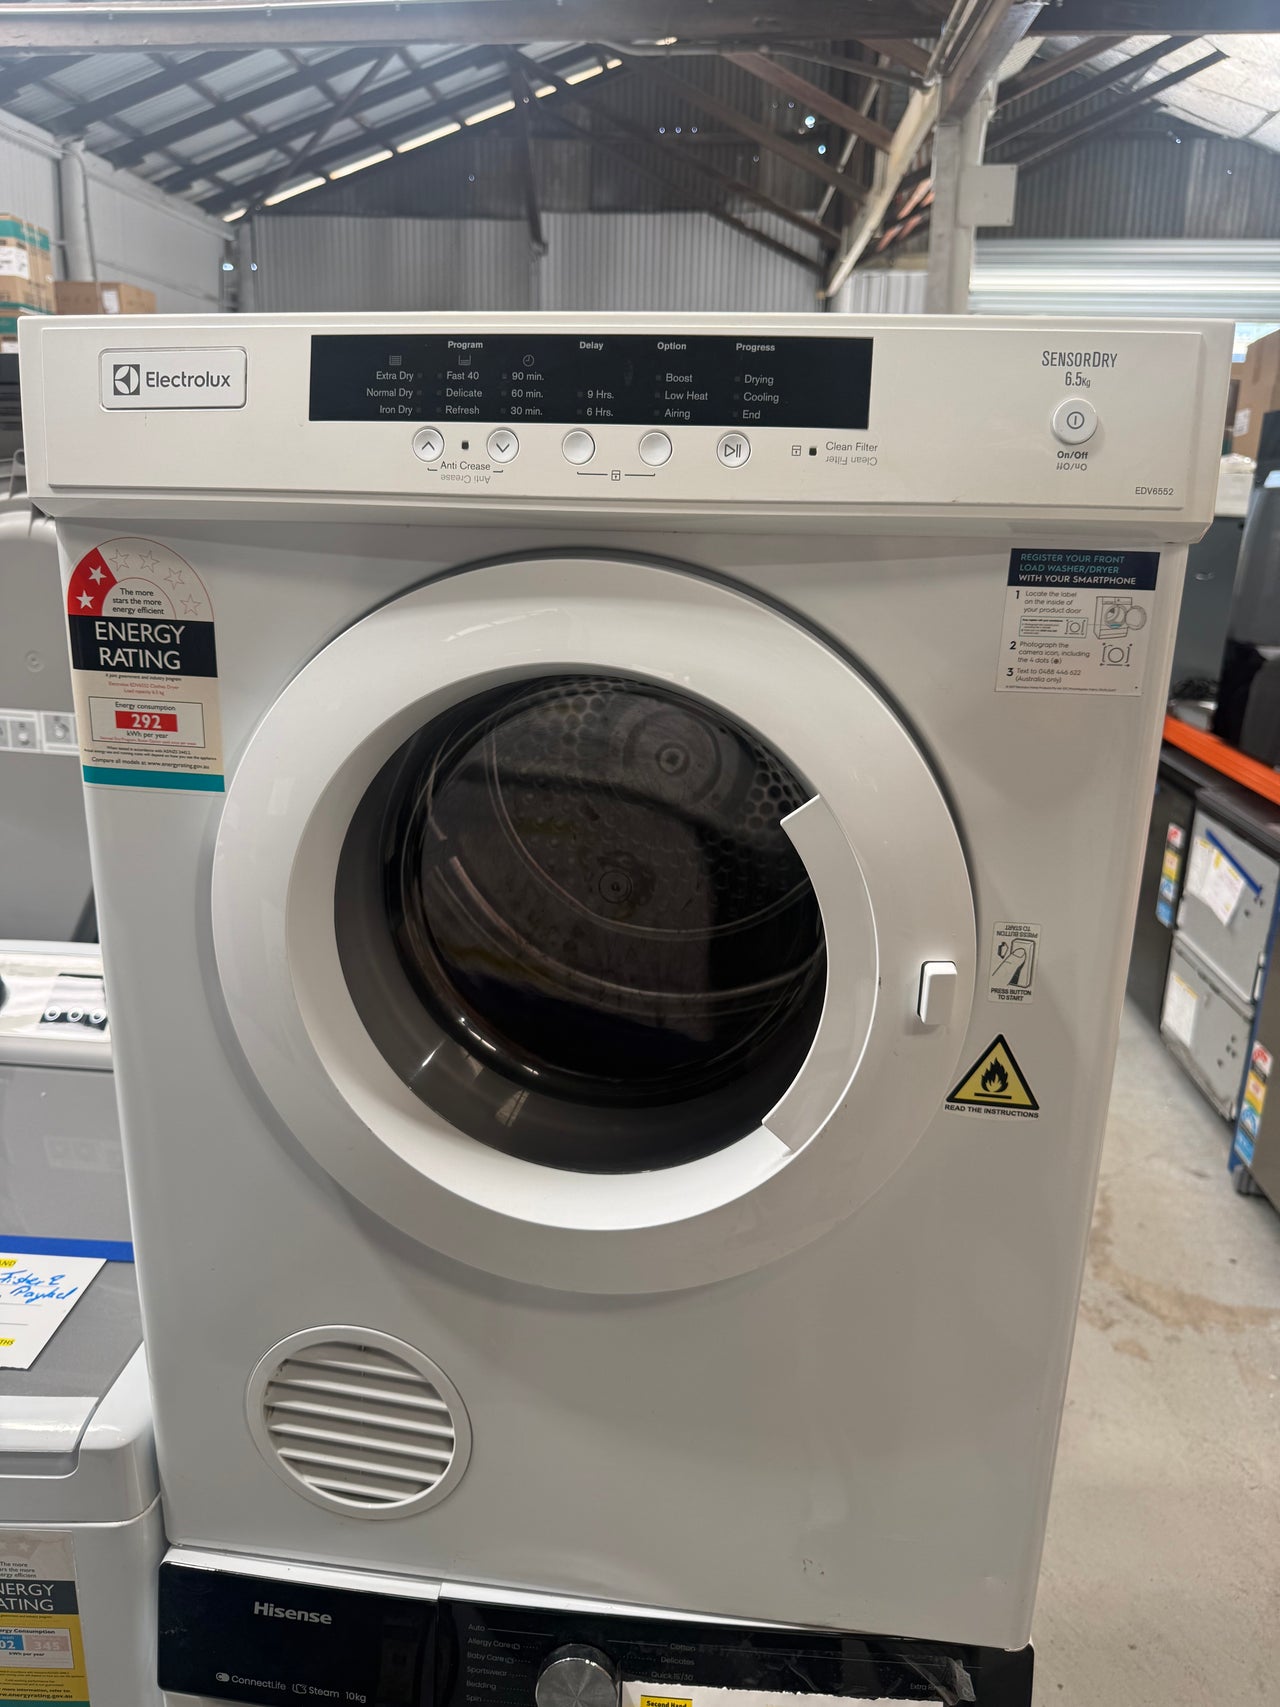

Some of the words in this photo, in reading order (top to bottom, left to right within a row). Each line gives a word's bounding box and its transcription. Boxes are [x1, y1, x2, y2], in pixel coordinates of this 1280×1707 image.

[447, 340, 483, 350] Program
[579, 341, 603, 351] Delay
[657, 341, 687, 351] Option
[735, 342, 775, 353] Progress
[146, 371, 231, 388] Electrolux
[376, 371, 397, 381] Extra
[399, 371, 414, 382] Dry
[446, 371, 465, 381] Fast
[466, 371, 480, 381] 40
[511, 371, 524, 381] 90
[526, 371, 545, 381] min.
[665, 373, 693, 383] Boost
[744, 374, 774, 386] Drying
[366, 388, 397, 397] Normal
[399, 388, 414, 399] Dry
[446, 388, 483, 398] Delicate
[511, 389, 524, 398] 60
[526, 389, 544, 398] min.
[587, 390, 594, 399] 9
[596, 390, 614, 399] Hrs.
[664, 390, 684, 401] Low
[686, 391, 708, 401] Heat
[743, 391, 779, 404] Cooling
[379, 405, 396, 415] Iron
[398, 405, 413, 416] Dry
[445, 405, 480, 415] Refresh
[510, 406, 523, 416] 30
[525, 406, 543, 416] min.
[586, 407, 593, 417] 6
[595, 408, 614, 417] Hrs.
[664, 408, 690, 420] Airing
[742, 409, 761, 420] End
[825, 441, 853, 452] Clean
[855, 442, 878, 453] Filter
[825, 455, 848, 465] Filter
[1057, 451, 1089, 460] On/Off
[851, 456, 878, 466] Clean
[440, 461, 457, 471] Anti
[459, 461, 491, 472] Crease
[1056, 462, 1088, 471] On/Off
[440, 473, 472, 483] Crease
[473, 474, 491, 484] Anti
[1135, 486, 1174, 496] EDV6552
[1020, 553, 1063, 562] REGISTER
[1065, 554, 1091, 563] YOUR
[1093, 555, 1125, 564] FRONT
[1019, 563, 1045, 572] LOAD
[1047, 564, 1120, 574] WASHER/DRYER
[1018, 574, 1042, 582] WITH
[1044, 574, 1070, 583] YOUR
[1072, 575, 1136, 585] SMARTPHONE
[119, 587, 134, 597] The
[1015, 590, 1020, 600] 1
[1025, 590, 1048, 598] Locate
[130, 598, 142, 606] the
[112, 607, 136, 615] energy
[137, 606, 164, 615] efficient
[95, 621, 186, 645] ENERGY
[1009, 641, 1017, 650] 2
[1019, 641, 1058, 650] Photograph
[99, 647, 181, 670] RATING
[1006, 667, 1014, 677] 3
[115, 701, 136, 710] Energy
[137, 703, 176, 711] consumption
[131, 713, 162, 729] 292
[143, 731, 153, 739] per
[991, 987, 1008, 995] PRESS
[1009, 988, 1032, 996] BUTTON
[944, 1104, 966, 1112] READ
[967, 1105, 982, 1114] THE
[983, 1107, 1039, 1119] INSTRUCTIONS
[253, 1601, 333, 1625] Hisense
[468, 1623, 486, 1632] Auto
[467, 1637, 493, 1647] Allergy
[493, 1640, 511, 1649] Care
[466, 1651, 486, 1661] Baby
[466, 1665, 507, 1677] Sportswear
[231, 1674, 287, 1691] ConnectLife
[466, 1679, 497, 1691] Bedding
[308, 1686, 340, 1698] Steam
[345, 1691, 367, 1704] 10kg
